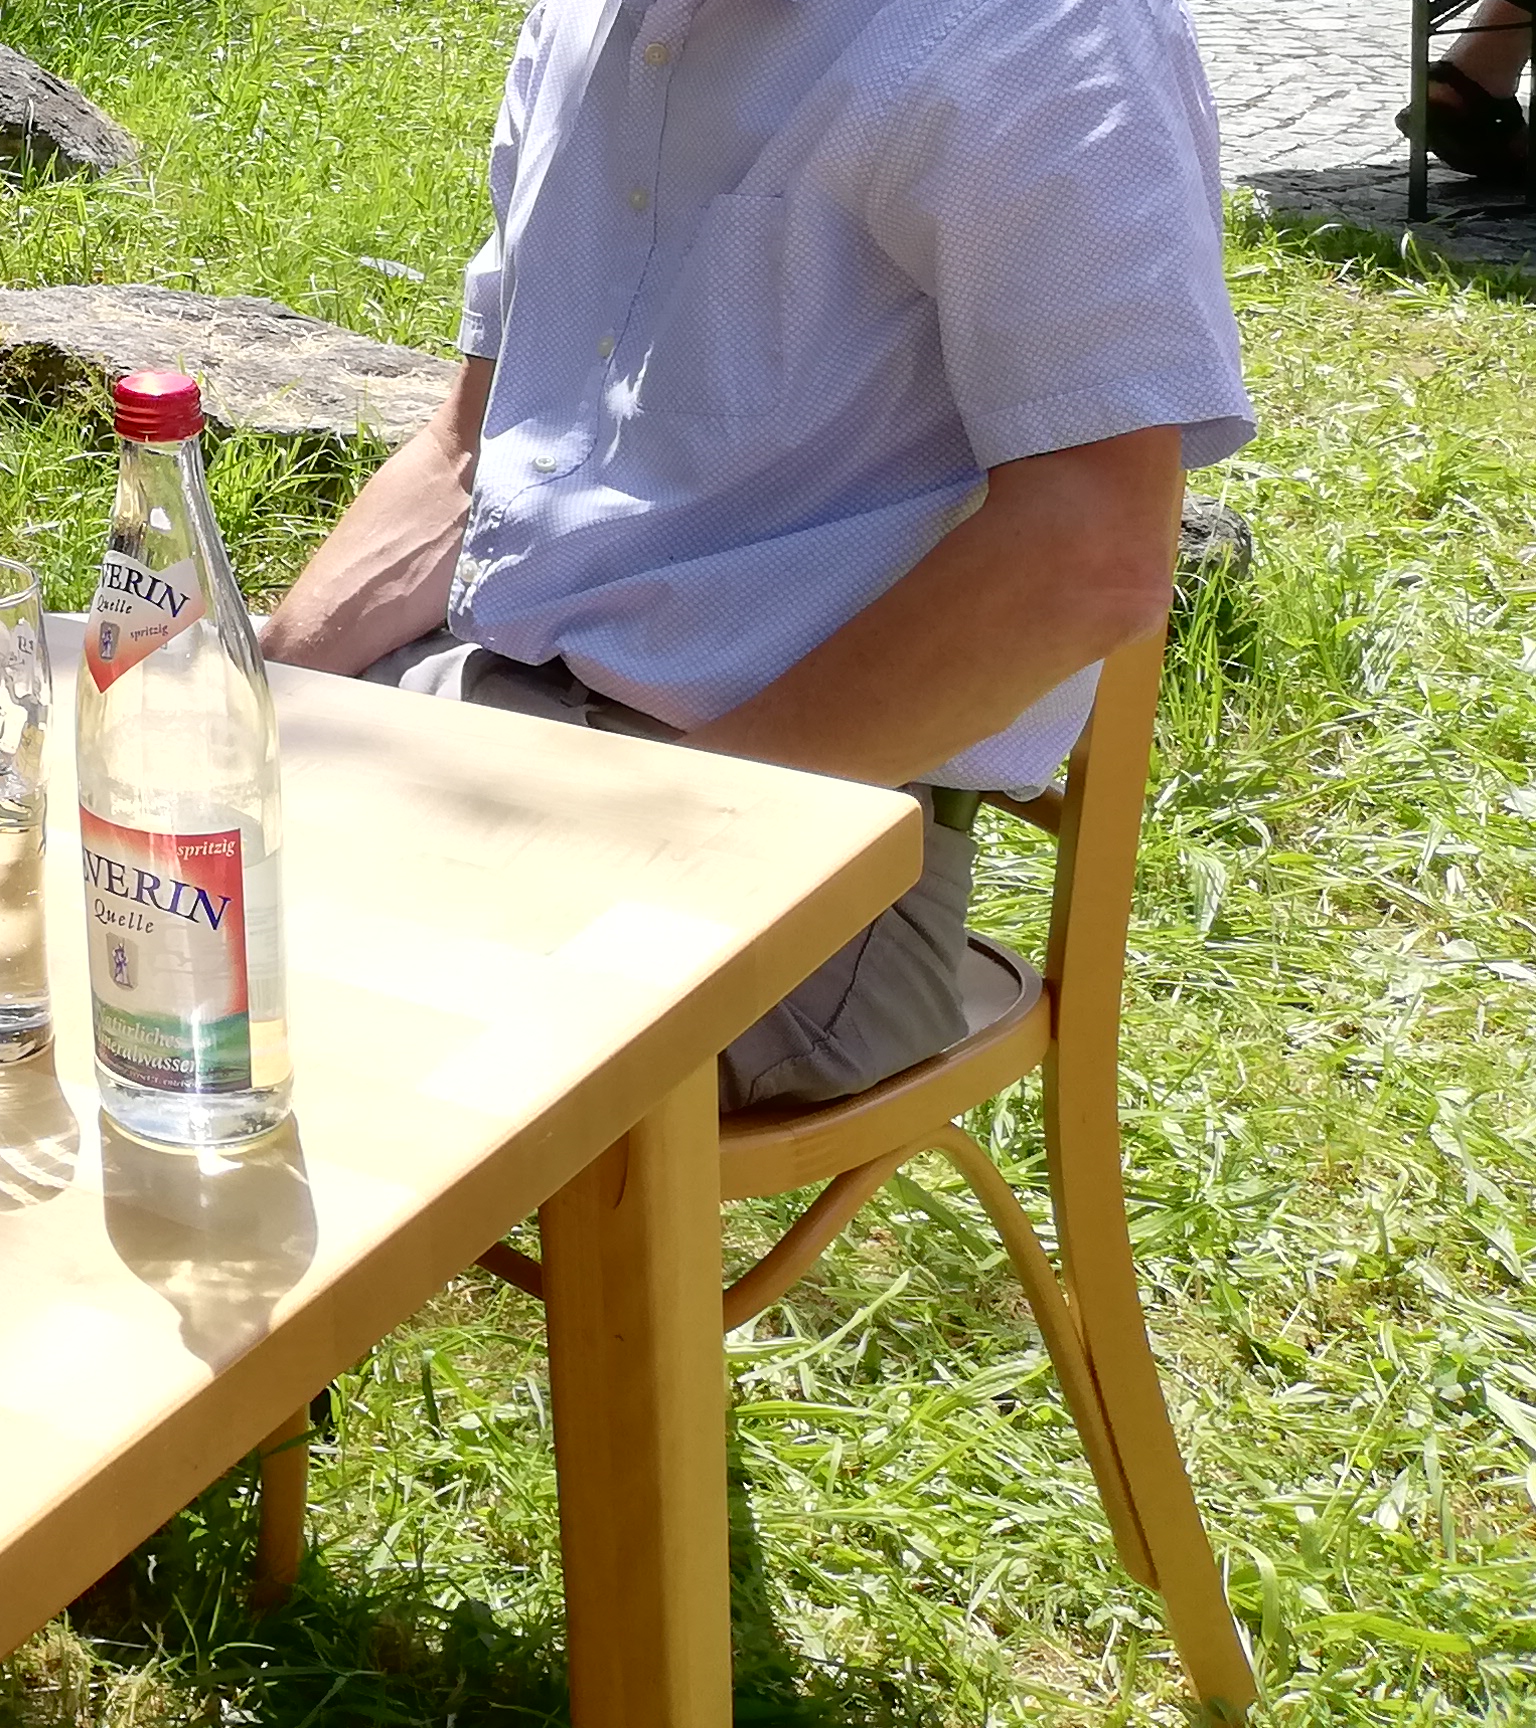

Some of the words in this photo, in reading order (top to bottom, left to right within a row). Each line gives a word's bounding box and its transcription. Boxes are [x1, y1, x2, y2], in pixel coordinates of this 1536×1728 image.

[96, 594, 133, 614] Quelle
[101, 562, 191, 619] VERIN
[130, 623, 169, 641] spritzig
[176, 838, 236, 861] spritzig
[83, 847, 231, 931] VERIN
[94, 898, 155, 934] Quelle
